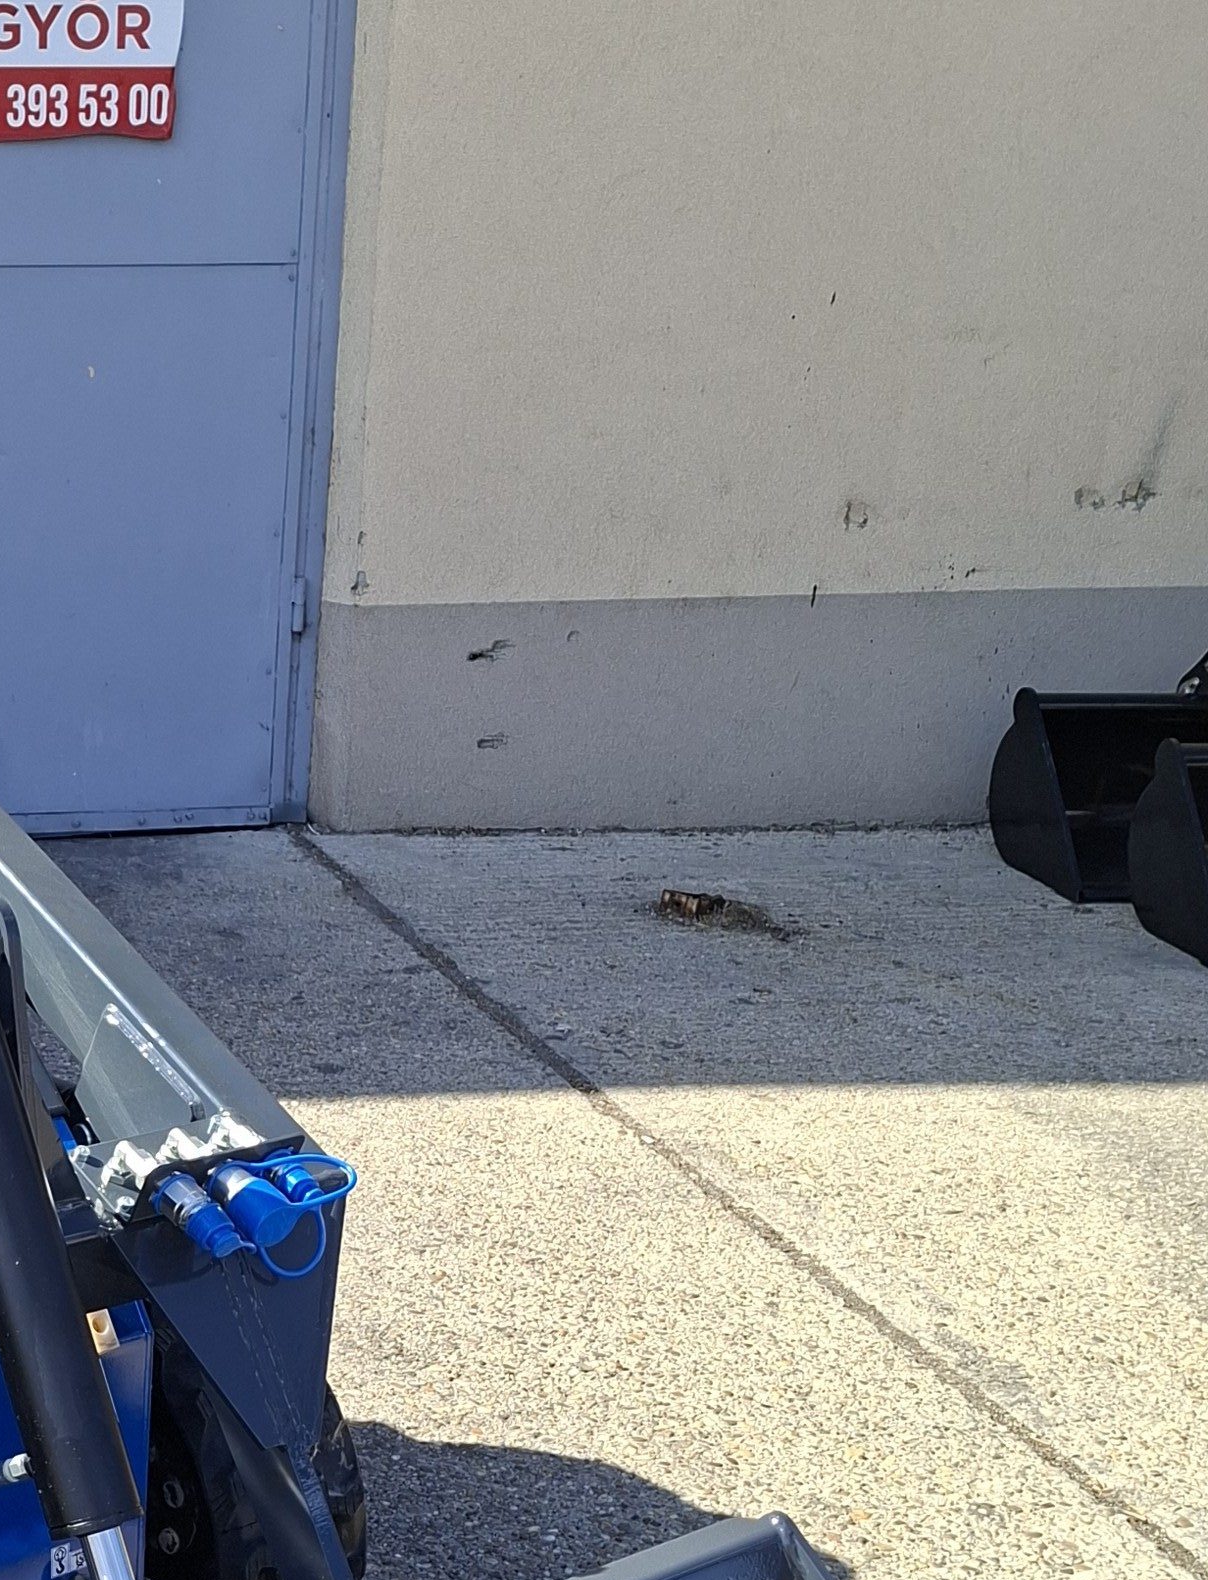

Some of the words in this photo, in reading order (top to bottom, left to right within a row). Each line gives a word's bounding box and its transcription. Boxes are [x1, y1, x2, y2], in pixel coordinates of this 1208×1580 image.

[6, 84, 69, 128] 393
[78, 84, 119, 127] 53
[128, 84, 170, 126] 00
